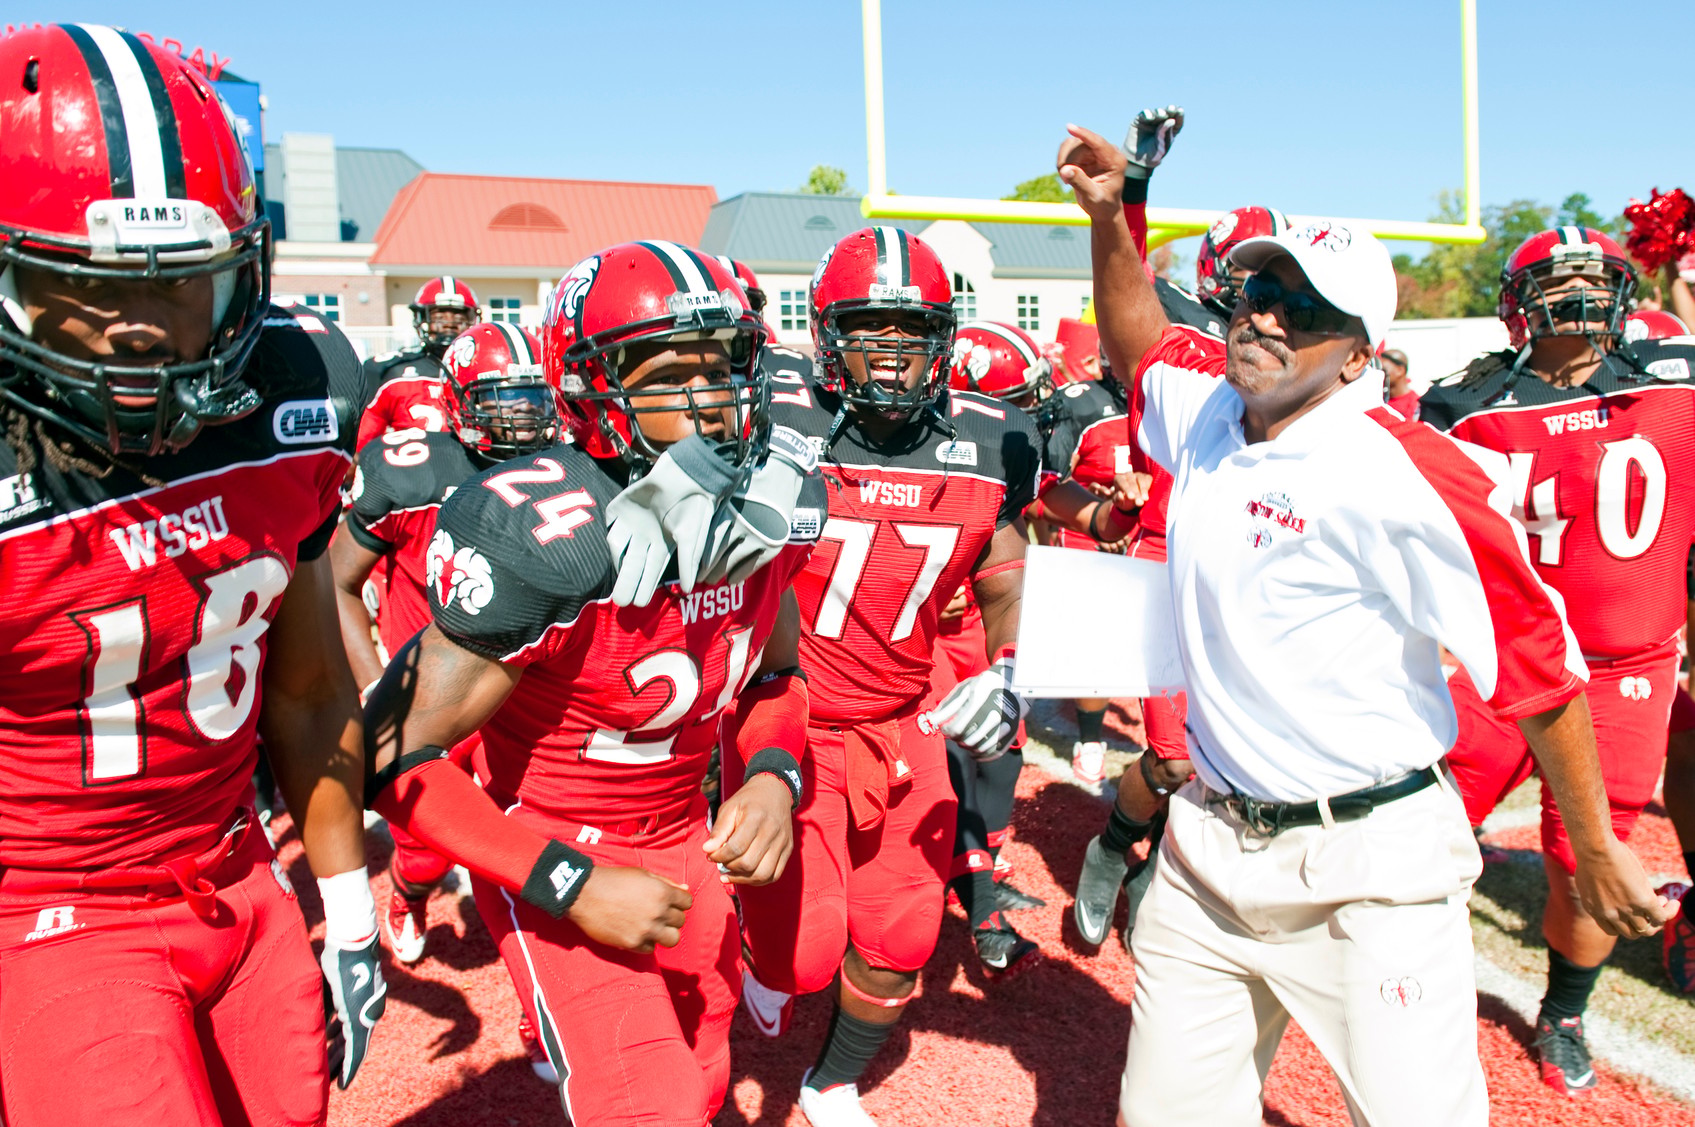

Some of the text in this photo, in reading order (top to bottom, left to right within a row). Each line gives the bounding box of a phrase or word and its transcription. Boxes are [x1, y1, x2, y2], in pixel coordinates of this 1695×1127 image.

[125, 206, 183, 222] RAMS
[882, 287, 909, 297] RAMS
[280, 408, 331, 438] CIAA
[1542, 408, 1608, 436] WSSU
[481, 457, 597, 546] 24
[858, 480, 923, 508] WSSU
[1502, 433, 1671, 568] 40
[109, 496, 230, 571] WSSU
[811, 514, 964, 646] 77
[680, 582, 746, 626] WSSU
[68, 550, 294, 788] 18
